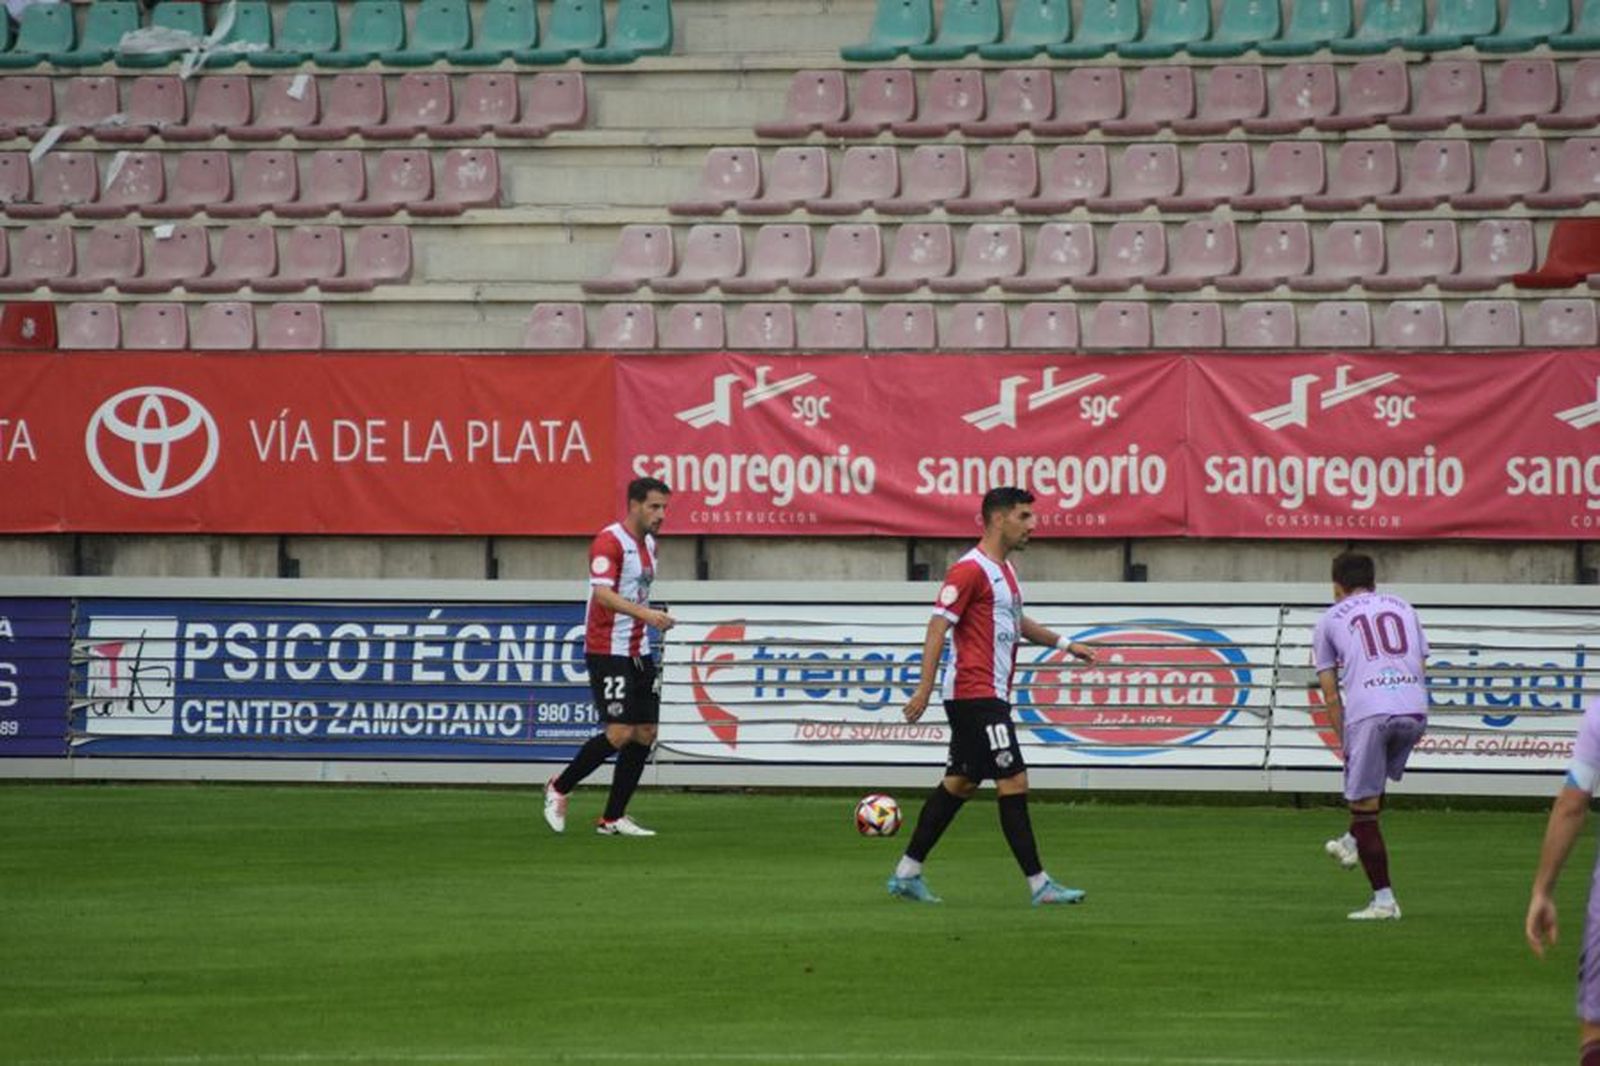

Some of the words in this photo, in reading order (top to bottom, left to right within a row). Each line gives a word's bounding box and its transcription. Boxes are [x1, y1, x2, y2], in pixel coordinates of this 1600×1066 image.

[792, 395, 831, 428] sgc
[1079, 395, 1120, 426] sgc
[1373, 394, 1416, 427] sgc
[249, 408, 319, 462] VÍA
[332, 420, 387, 462] DE
[402, 420, 453, 462] LA
[467, 420, 592, 463] PLATA
[632, 445, 876, 507] sangregorio
[1204, 445, 1464, 510] sangregorio
[690, 510, 818, 524] CONSTRUCCION
[1264, 513, 1402, 529] CONSTRUCCION
[182, 608, 590, 682] PSICOTÉCNIC
[1348, 611, 1410, 662] 10
[603, 676, 626, 700] 22
[1054, 652, 1218, 705] frinca
[180, 699, 317, 736] CENTRO
[327, 700, 524, 737] ZAMORANO
[538, 703, 570, 722] 980
[849, 719, 944, 740] solutions
[986, 723, 1011, 751] 10
